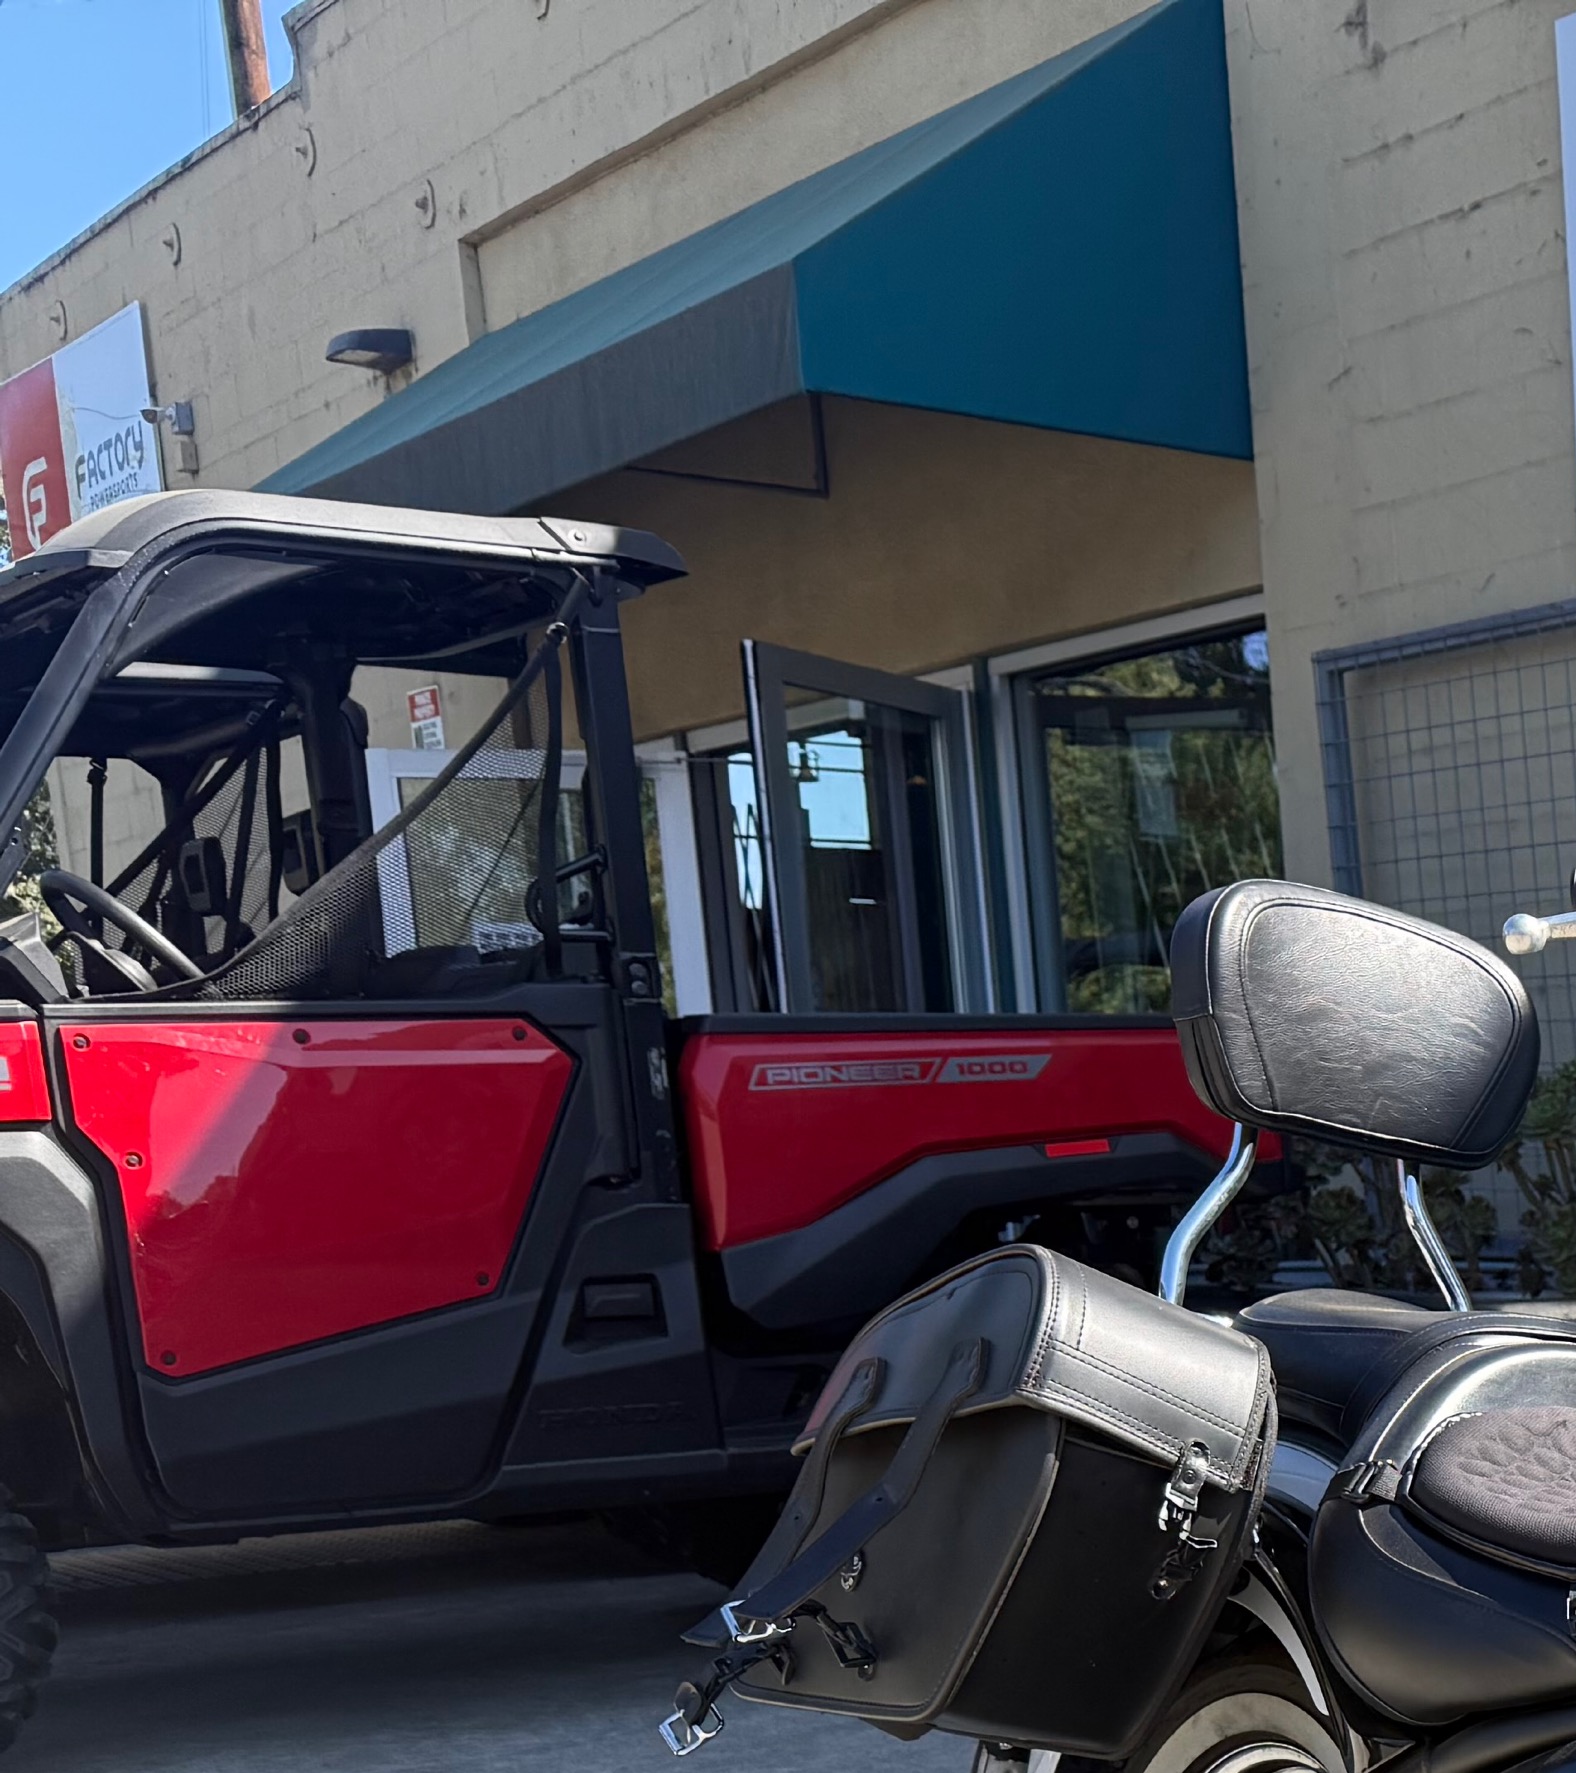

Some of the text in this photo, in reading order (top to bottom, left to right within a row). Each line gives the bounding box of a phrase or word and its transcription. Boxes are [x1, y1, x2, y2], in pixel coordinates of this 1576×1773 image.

[75, 421, 144, 500] FACTORY
[766, 1059, 1028, 1085] PIONEER 1000
